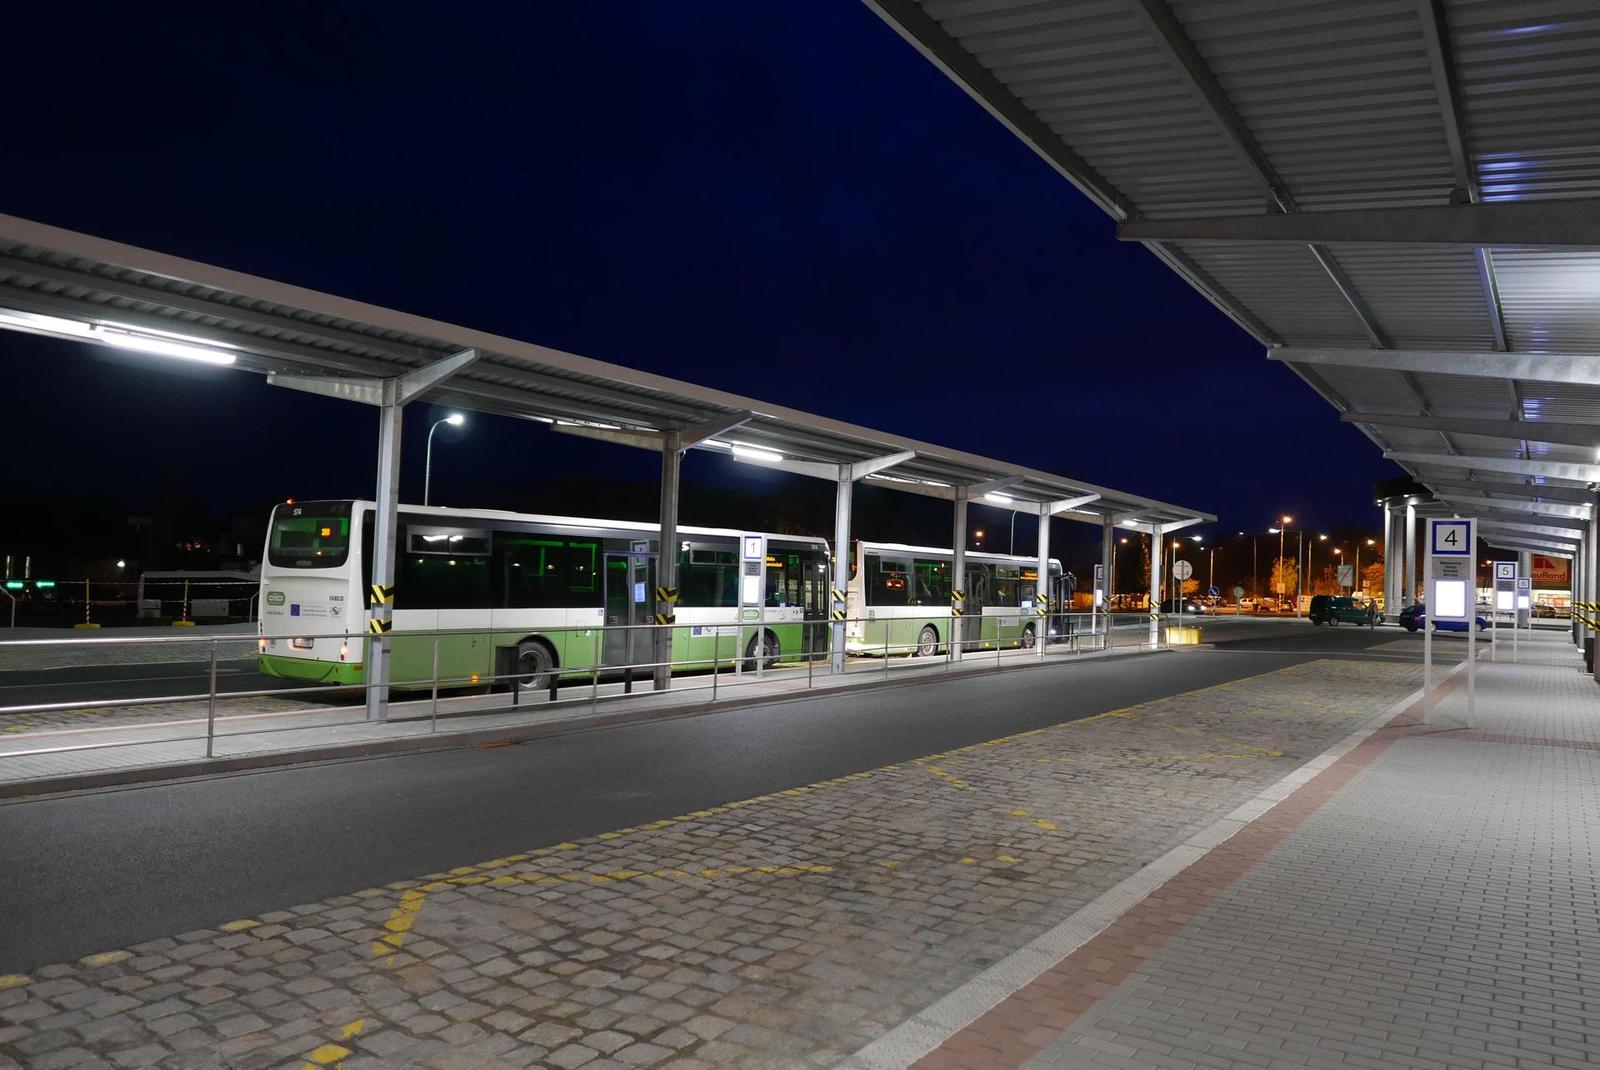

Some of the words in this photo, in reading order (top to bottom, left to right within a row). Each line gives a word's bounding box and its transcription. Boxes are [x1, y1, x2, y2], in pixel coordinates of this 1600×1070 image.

[1444, 529, 1458, 546] 4
[751, 542, 756, 554] 1
[1502, 567, 1509, 576] 5
